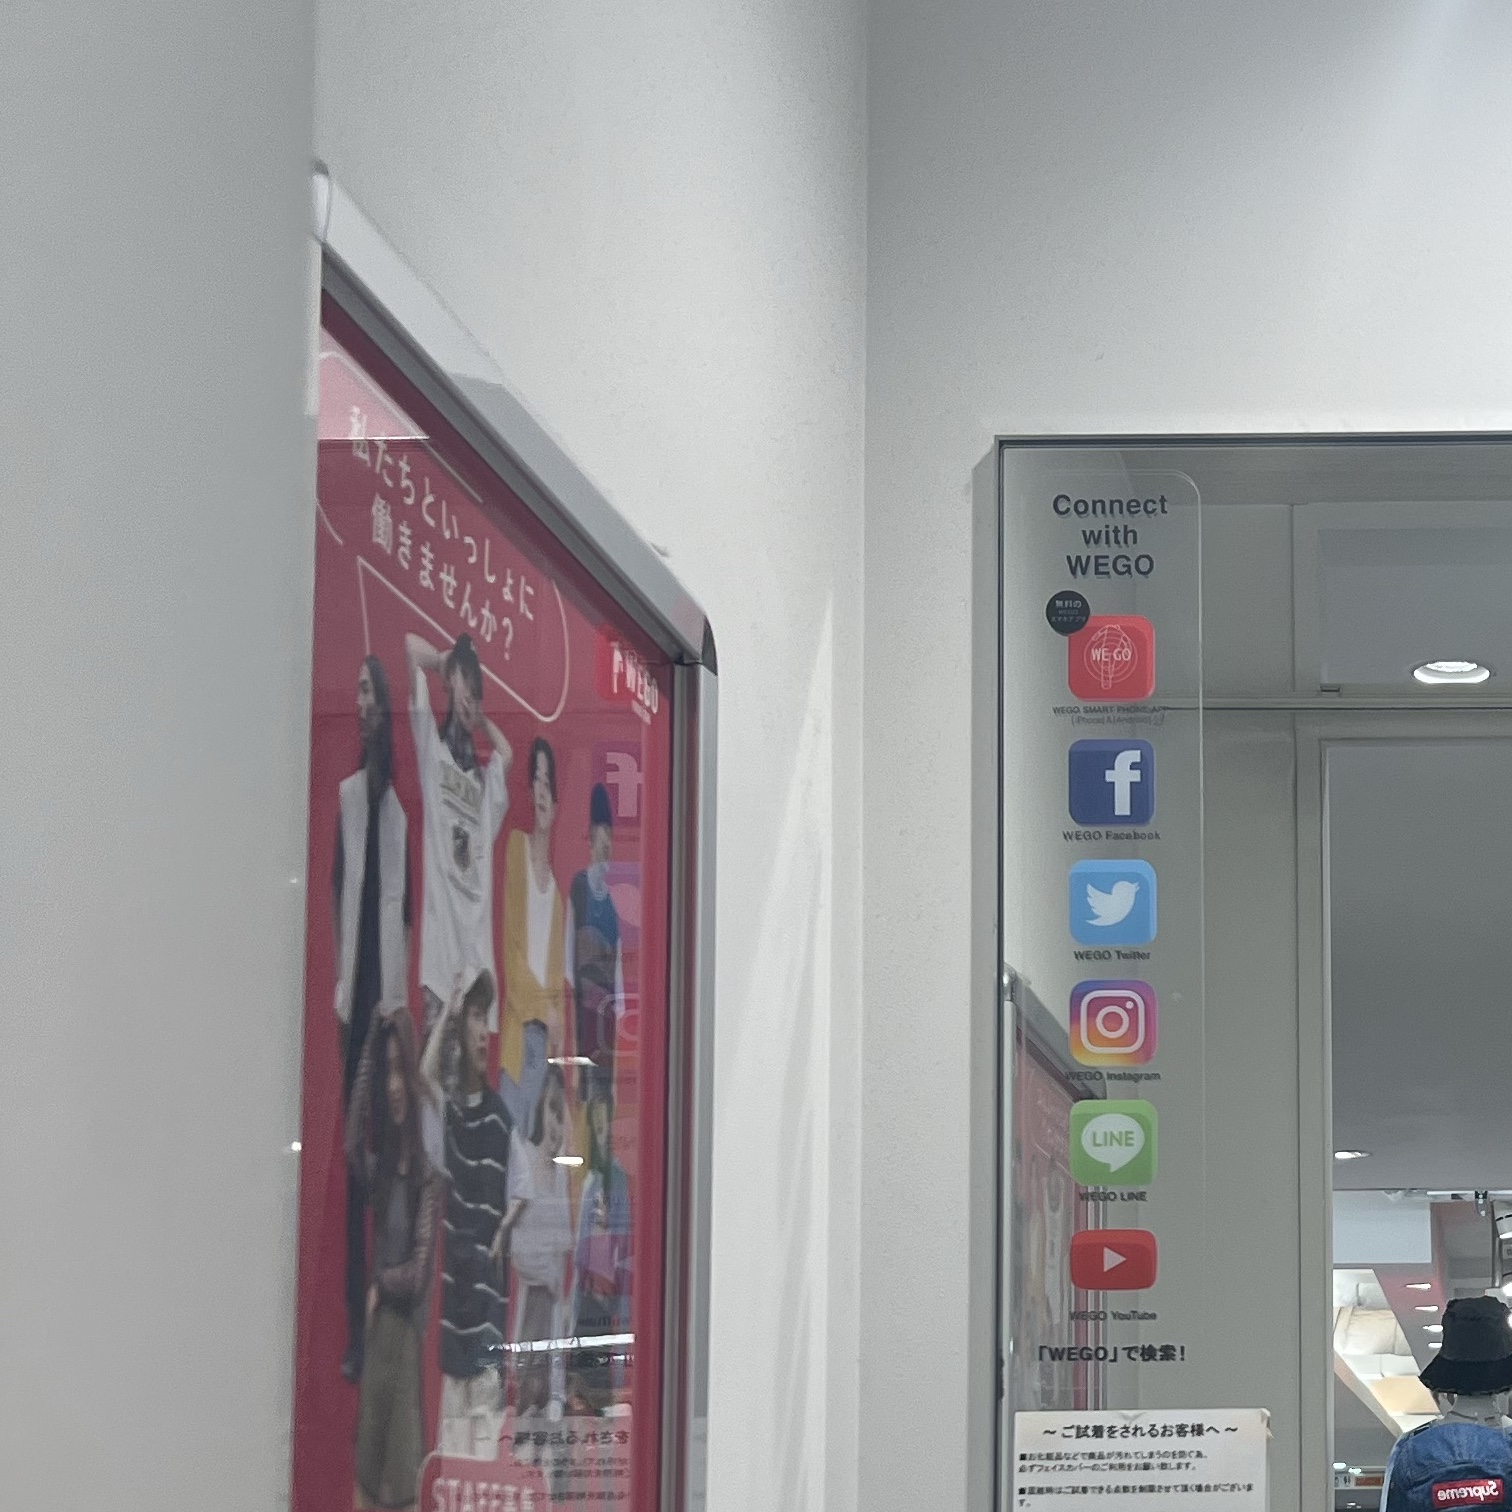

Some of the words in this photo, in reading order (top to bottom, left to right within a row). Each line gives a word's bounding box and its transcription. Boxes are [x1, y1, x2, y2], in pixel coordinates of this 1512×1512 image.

[1053, 494, 1168, 516] Connect
[349, 405, 535, 622] 私たちといっしょに
[1081, 524, 1138, 545] with
[1066, 554, 1155, 576] WEGO
[371, 493, 514, 661] 働きませんか？
[1053, 706, 1079, 715] WEGO
[1083, 706, 1113, 714] SMART
[1062, 831, 1102, 841] WEGO
[1105, 831, 1161, 841] Facebook
[1074, 950, 1112, 961] WEGO
[1116, 950, 1151, 961] Twitter
[1066, 1071, 1103, 1081] WEGO
[1106, 1071, 1161, 1083] Instagram
[1092, 1131, 1135, 1147] LINE
[1080, 1191, 1117, 1201] WEGO
[1120, 1191, 1148, 1201] LINE
[1069, 1311, 1107, 1320] WEGO
[1111, 1310, 1157, 1320] YouTube
